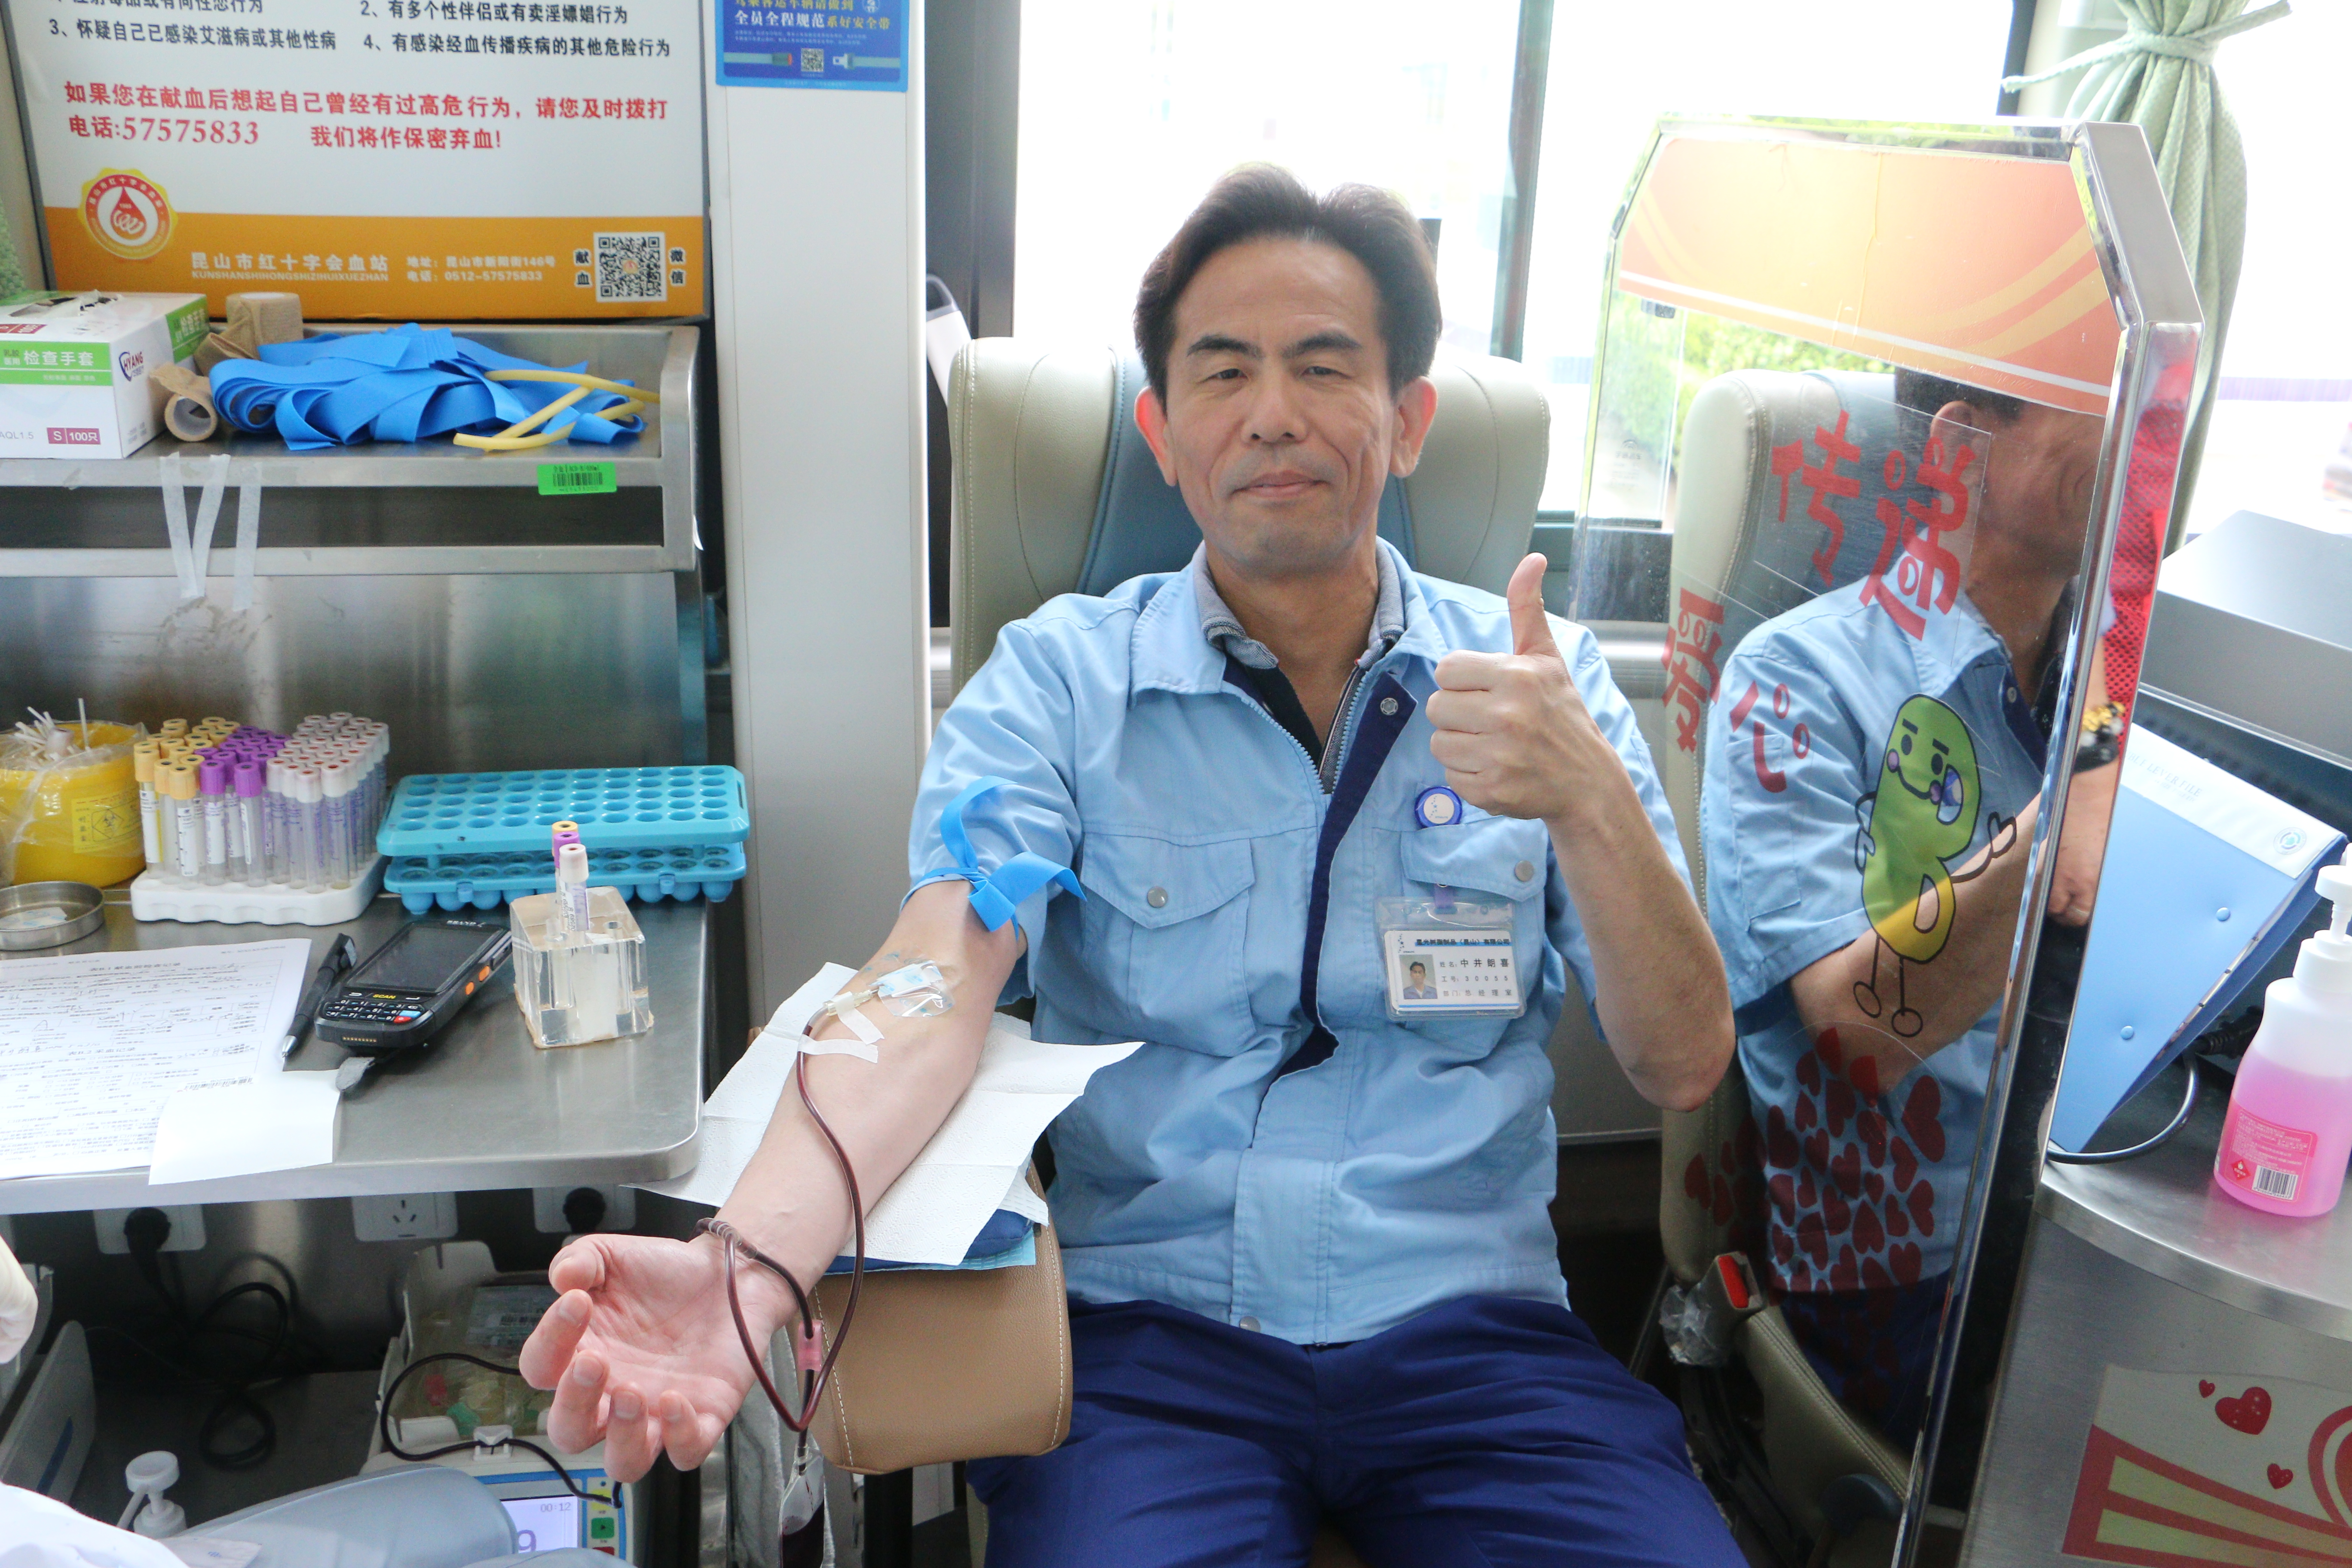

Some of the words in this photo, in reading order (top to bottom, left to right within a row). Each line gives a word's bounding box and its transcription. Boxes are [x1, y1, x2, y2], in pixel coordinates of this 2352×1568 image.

[735, 10, 825, 28] 全员全程规范
[191, 251, 389, 271] 昆山市红十字会血站
[24, 351, 94, 366] 检查手套
[53, 431, 62, 441] S
[70, 432, 98, 441] 100只
[540, 1502, 571, 1513] 00:12
